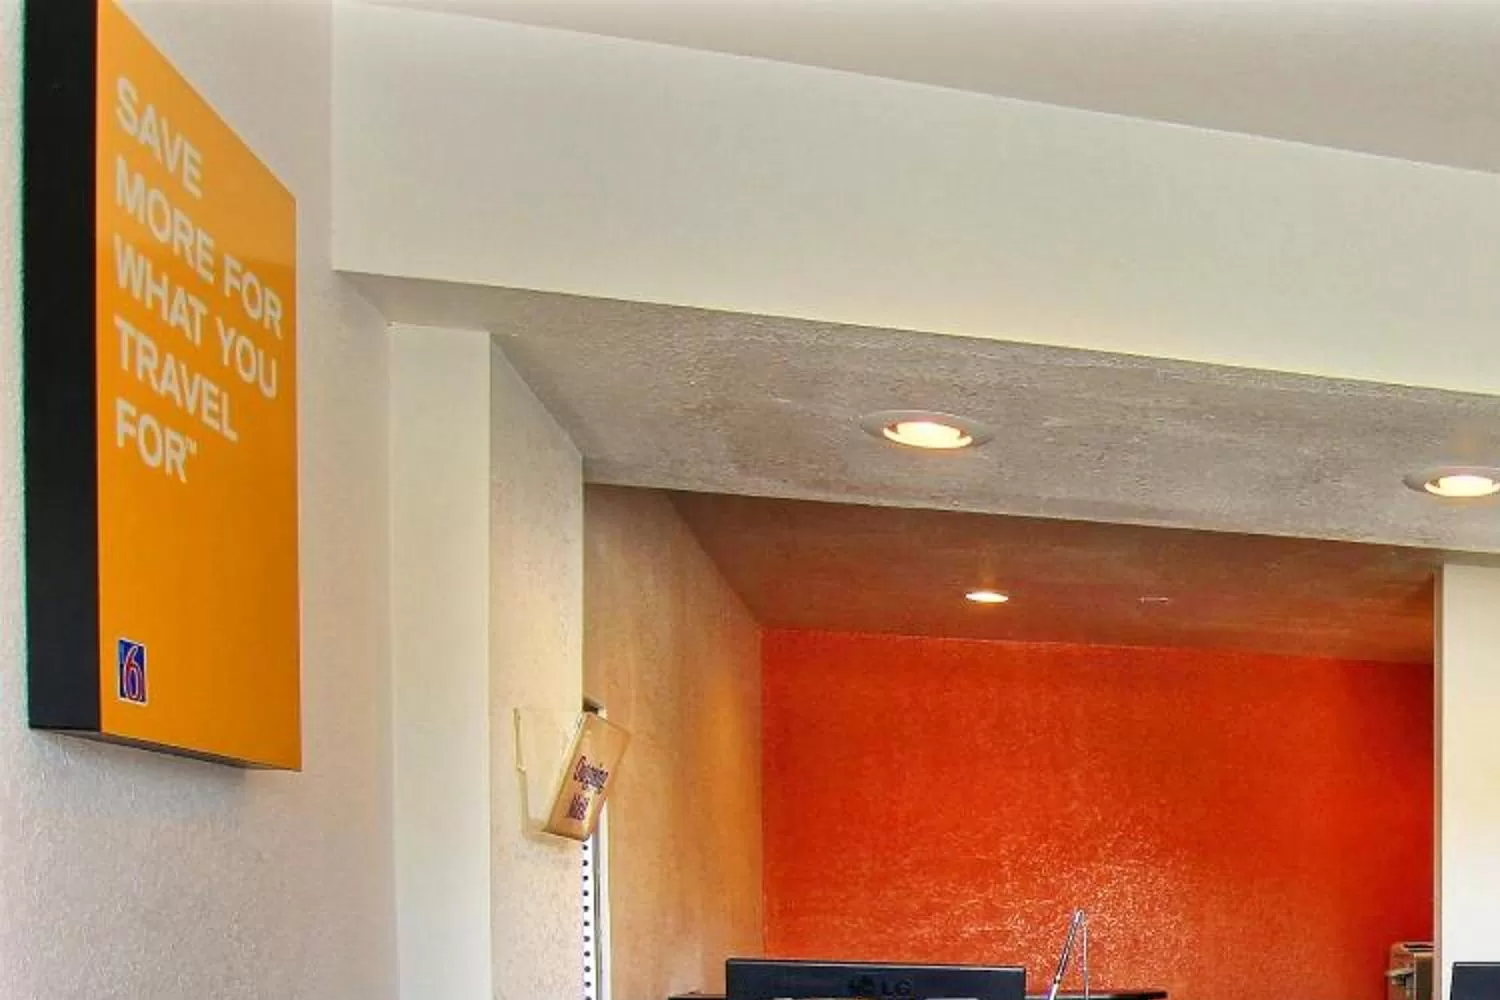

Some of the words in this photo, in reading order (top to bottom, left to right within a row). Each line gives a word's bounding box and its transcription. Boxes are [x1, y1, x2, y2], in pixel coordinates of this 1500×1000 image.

[116, 76, 203, 199] SAVE
[116, 155, 215, 284] MORE
[223, 252, 283, 340] FOR
[113, 313, 239, 442] TRAVEL
[115, 232, 208, 347] WHAT
[216, 315, 278, 399] YOU
[123, 644, 143, 701] 6
